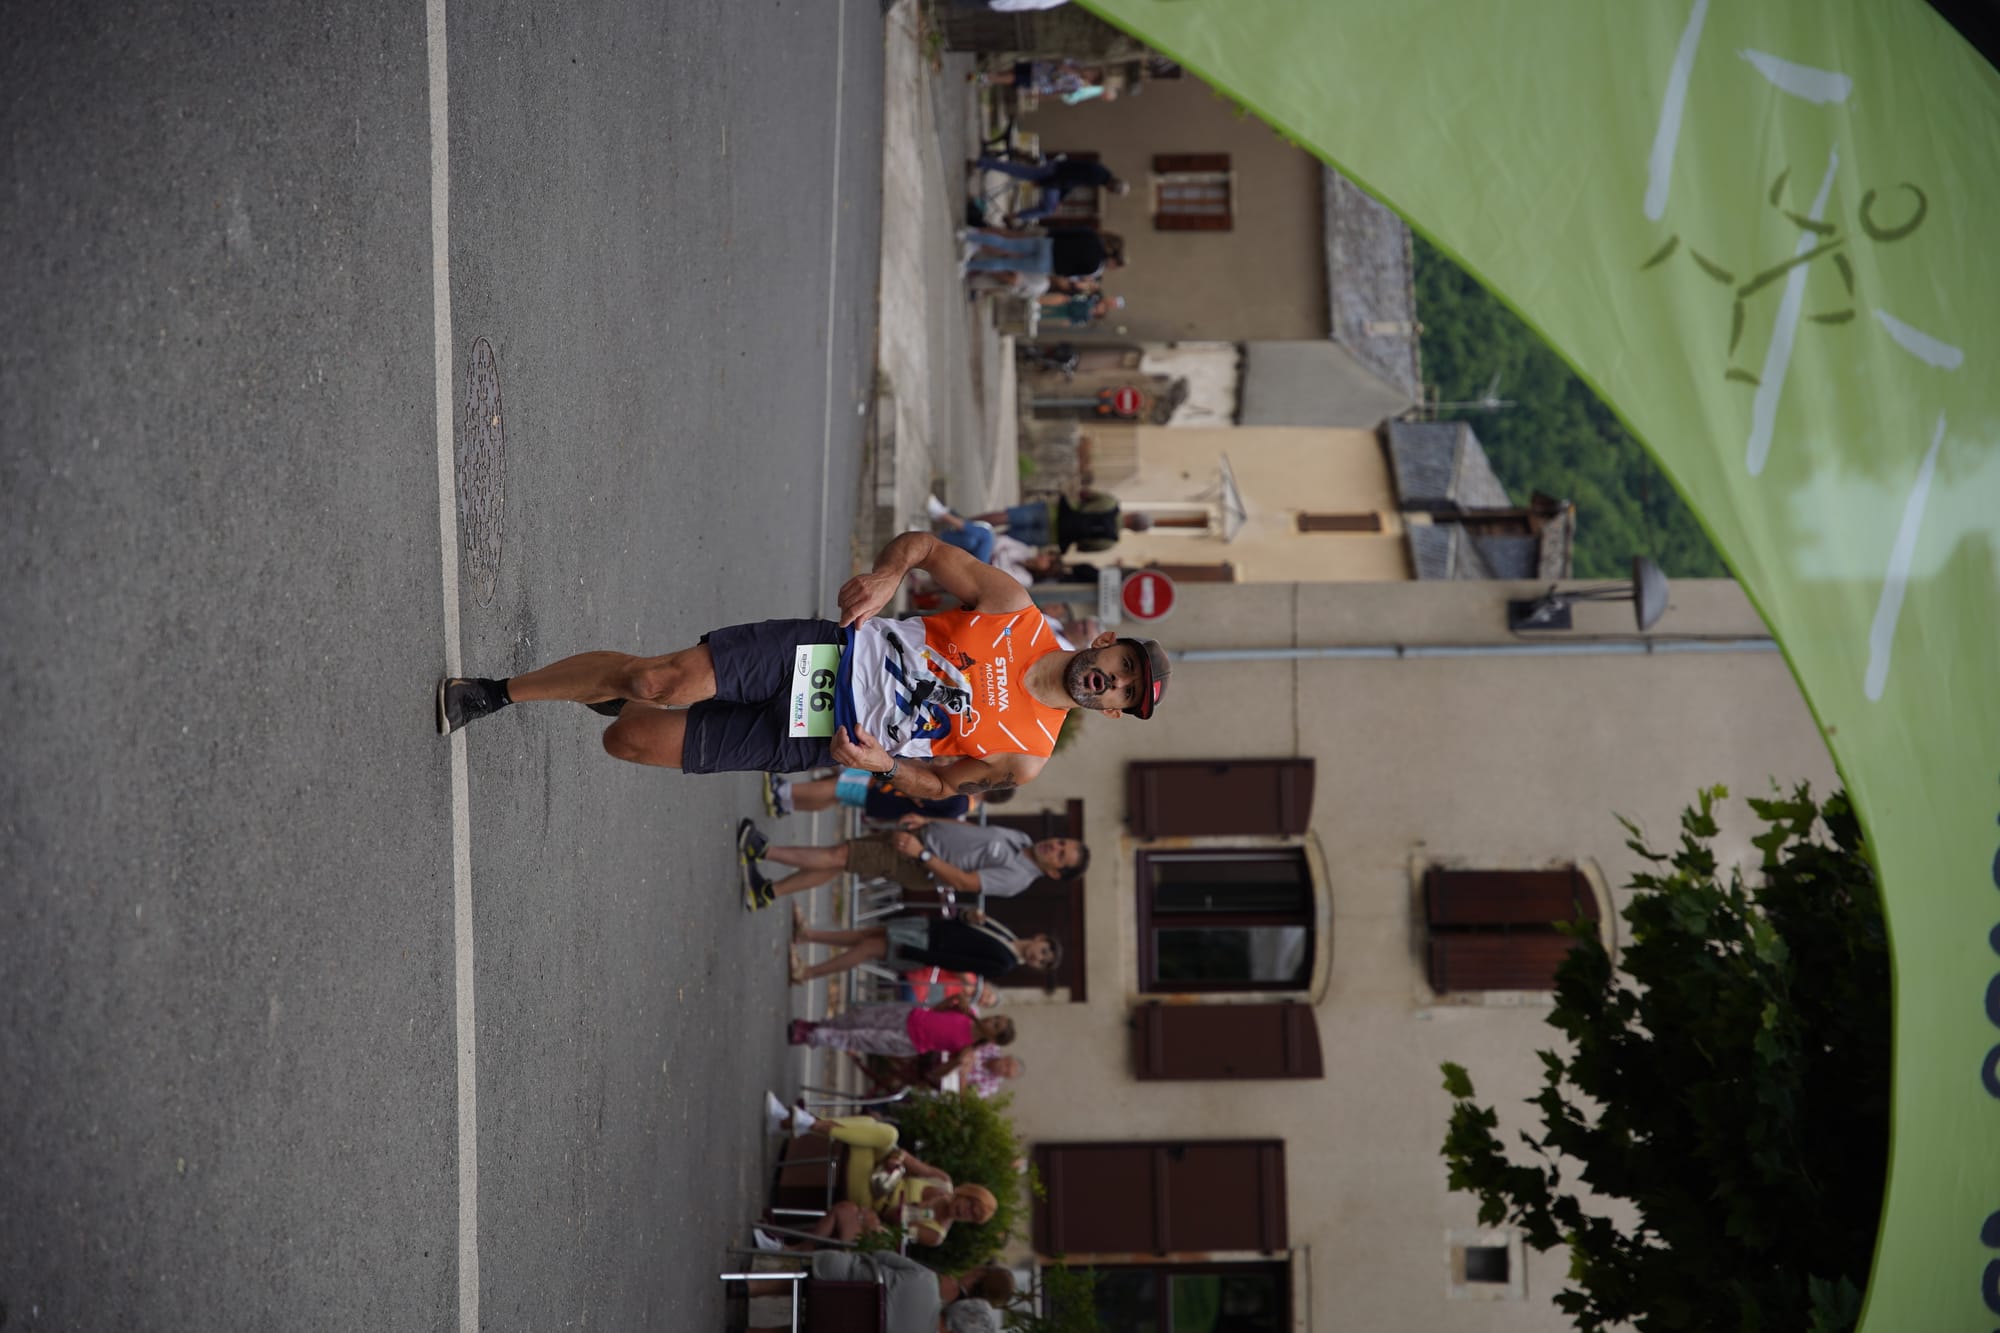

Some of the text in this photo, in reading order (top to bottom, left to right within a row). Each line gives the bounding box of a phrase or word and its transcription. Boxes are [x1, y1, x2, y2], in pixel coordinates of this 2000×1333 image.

[810, 668, 835, 712] 66
[985, 662, 996, 706] MOULINS
[995, 656, 1009, 712] STRAVA
